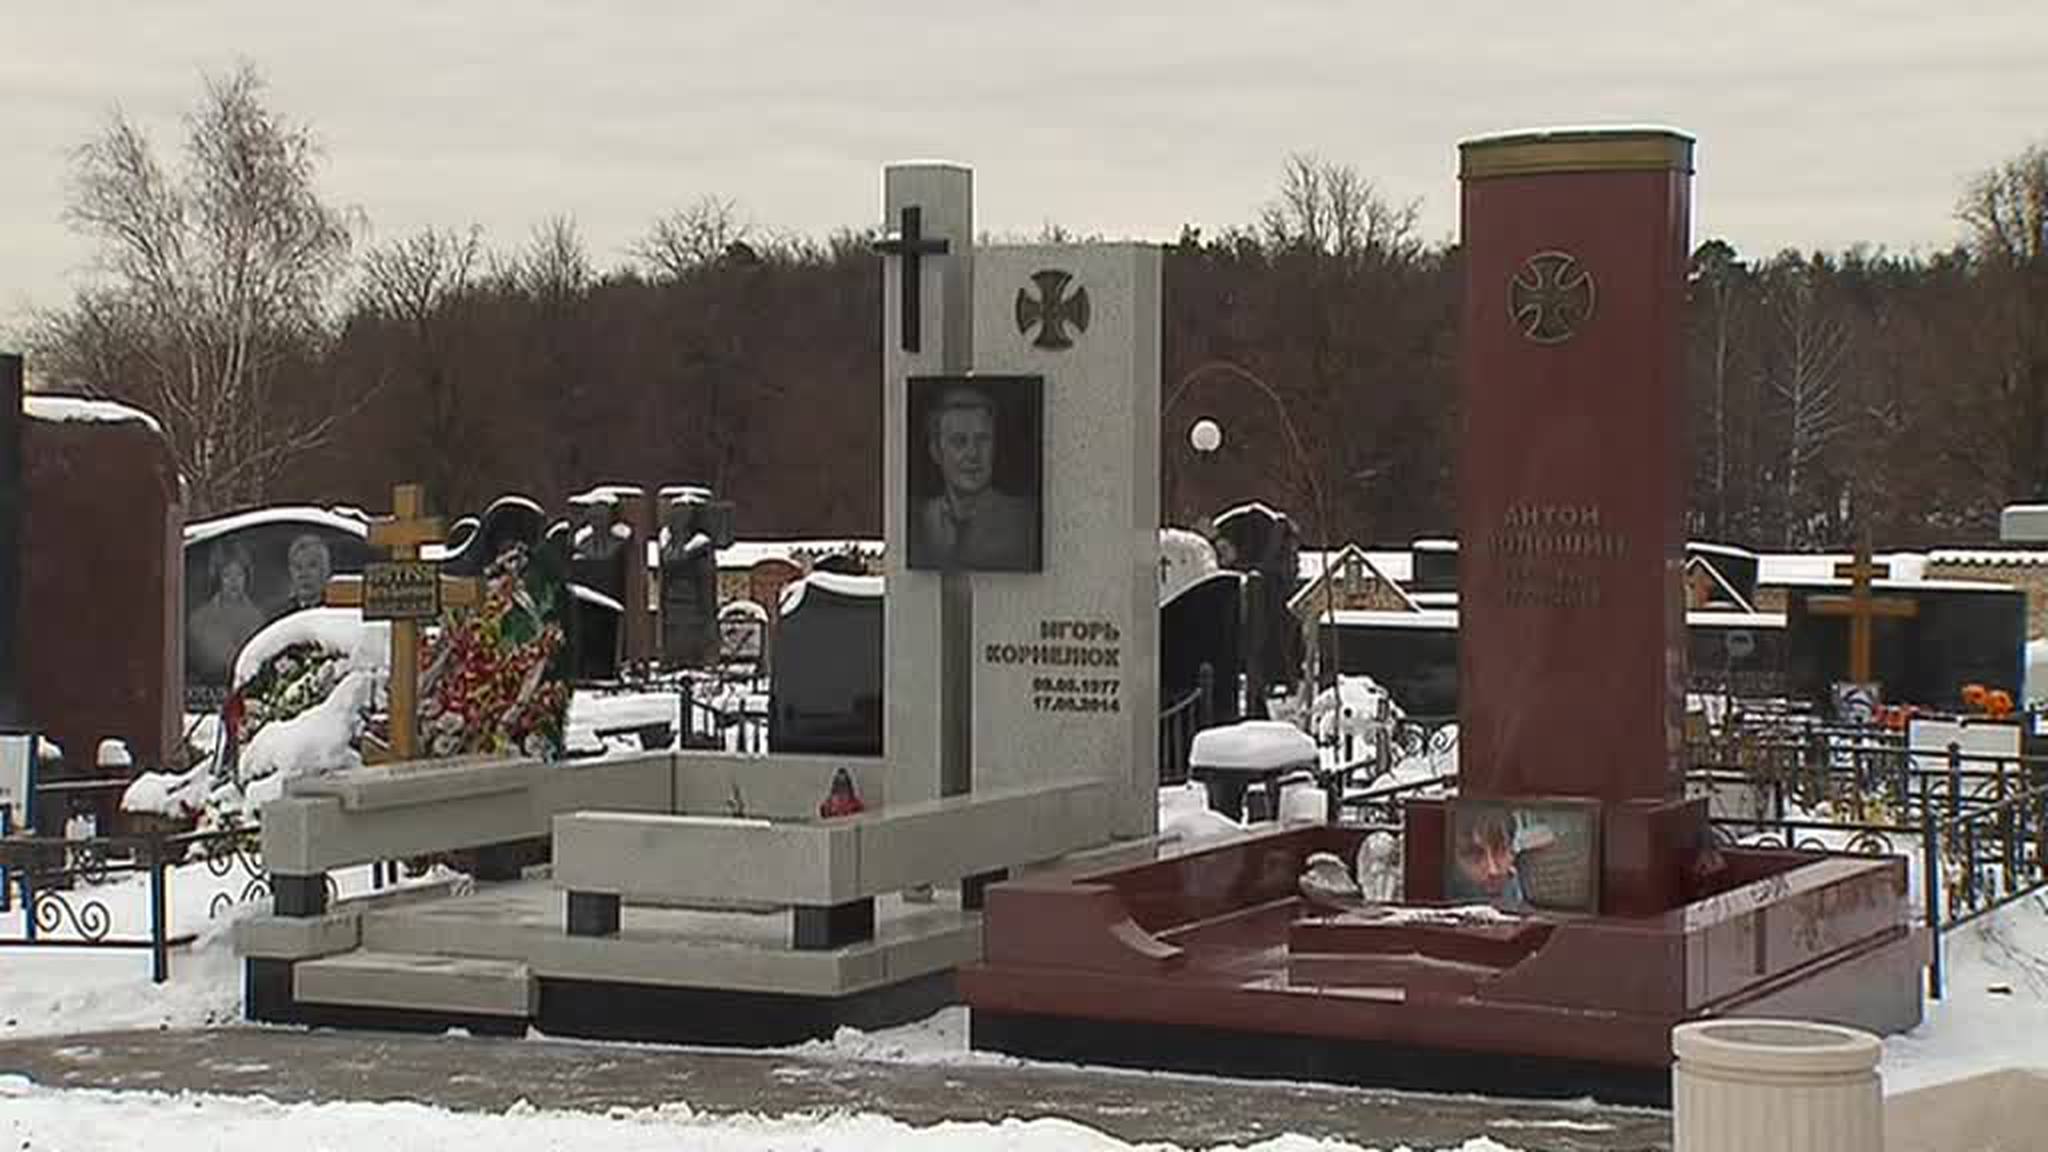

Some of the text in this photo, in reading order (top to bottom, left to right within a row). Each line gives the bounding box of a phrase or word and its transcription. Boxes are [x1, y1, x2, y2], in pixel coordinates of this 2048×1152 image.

[1504, 505, 1600, 527] АНТОН
[1040, 619, 1121, 641] ИГОРЬ
[985, 643, 1120, 667] КОРНЕЛЮК
